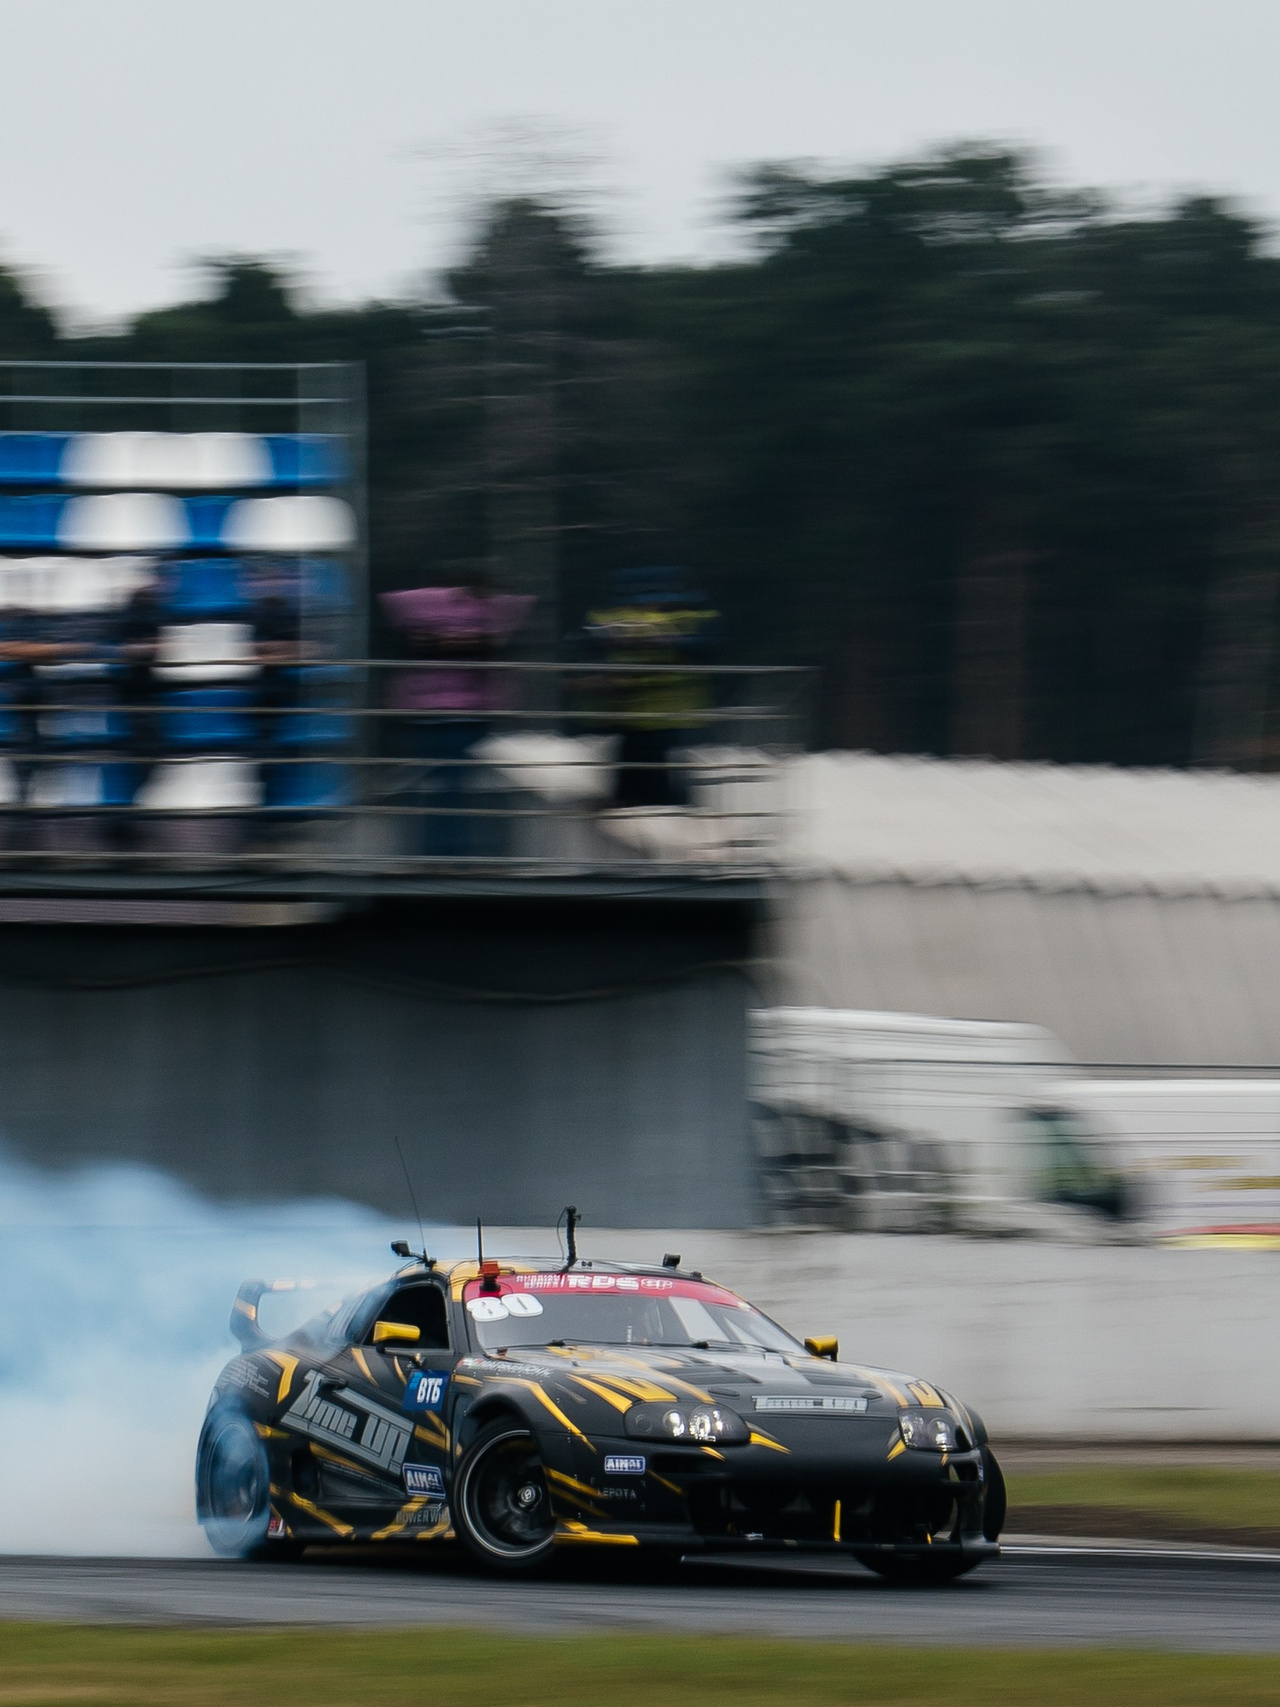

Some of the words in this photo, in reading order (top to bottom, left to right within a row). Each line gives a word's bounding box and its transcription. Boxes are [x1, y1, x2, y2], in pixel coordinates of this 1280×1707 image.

[567, 1275, 639, 1290] RDS
[466, 1293, 543, 1322] 80
[416, 1377, 443, 1404] ВТБ
